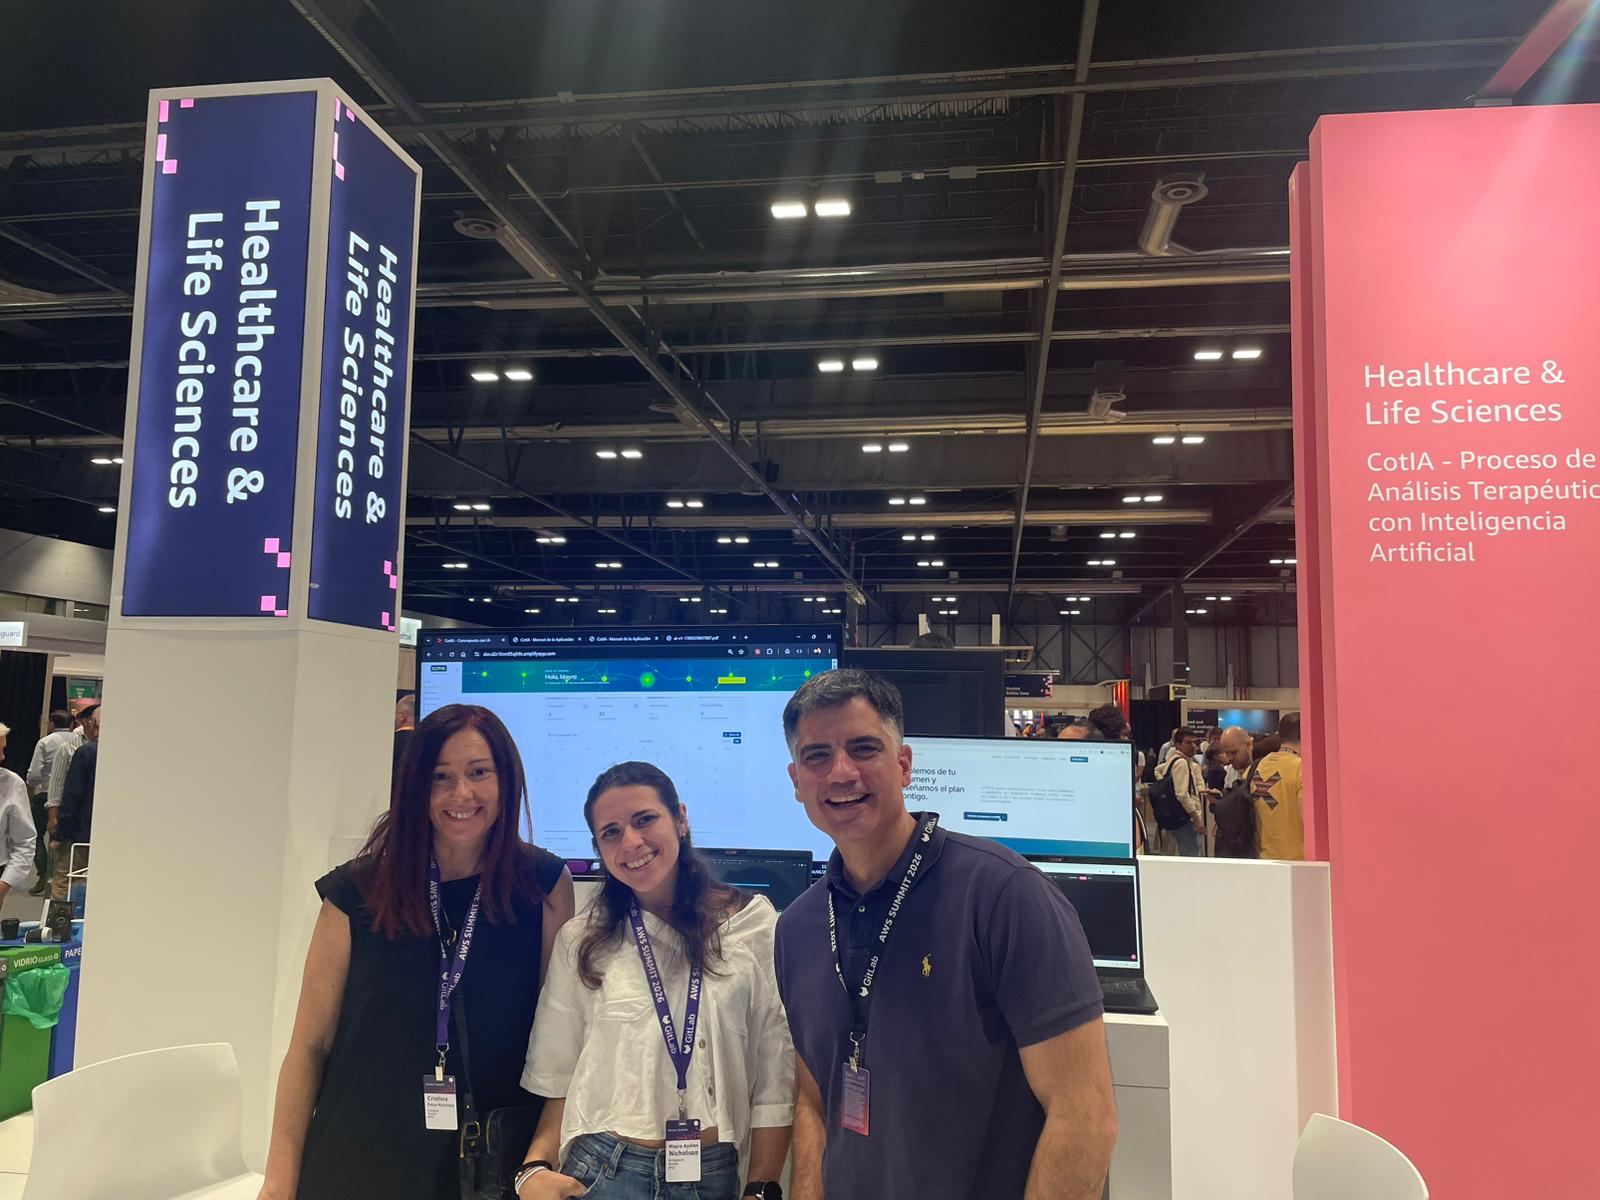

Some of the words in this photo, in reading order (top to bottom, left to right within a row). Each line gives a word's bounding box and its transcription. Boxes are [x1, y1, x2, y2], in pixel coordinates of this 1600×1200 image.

[183, 211, 223, 296] Life
[345, 230, 369, 317] Life
[229, 199, 281, 453] Healthcare
[368, 243, 398, 479] Healthcare
[1364, 361, 1530, 388] Healthcare
[1540, 359, 1566, 384] &
[168, 310, 217, 509] Sciences
[1365, 400, 1421, 425] Life
[1431, 398, 1563, 424] Sciences
[335, 331, 365, 519] Sciences
[1366, 451, 1435, 472] CotIA
[1460, 450, 1558, 470] Proceso
[1566, 448, 1596, 469] de
[226, 467, 265, 504] &
[1367, 480, 1462, 502] Análisis
[1467, 478, 1600, 504] Terapéutic
[365, 490, 386, 524] &
[1368, 515, 1412, 532] con
[1421, 511, 1567, 536] Inteligencia
[1369, 541, 1476, 562] Artificial
[0, 631, 21, 639] guard
[948, 785, 965, 794] plan
[429, 880, 438, 899] AWS
[878, 916, 893, 943] AWS
[889, 877, 912, 919] SUMMIT
[908, 852, 923, 877] 2026
[459, 940, 469, 960] AWS
[464, 904, 478, 938] SUMMIT
[13, 956, 38, 968] VIDRIO
[64, 946, 82, 959] PAPE
[635, 926, 646, 943] AWS
[641, 943, 658, 980] SUMMIT
[652, 979, 665, 1003] 2026
[863, 955, 879, 987] GitLab
[690, 978, 700, 1000] AWS
[662, 1024, 678, 1054] GitLab
[684, 1013, 696, 1044] GitLab
